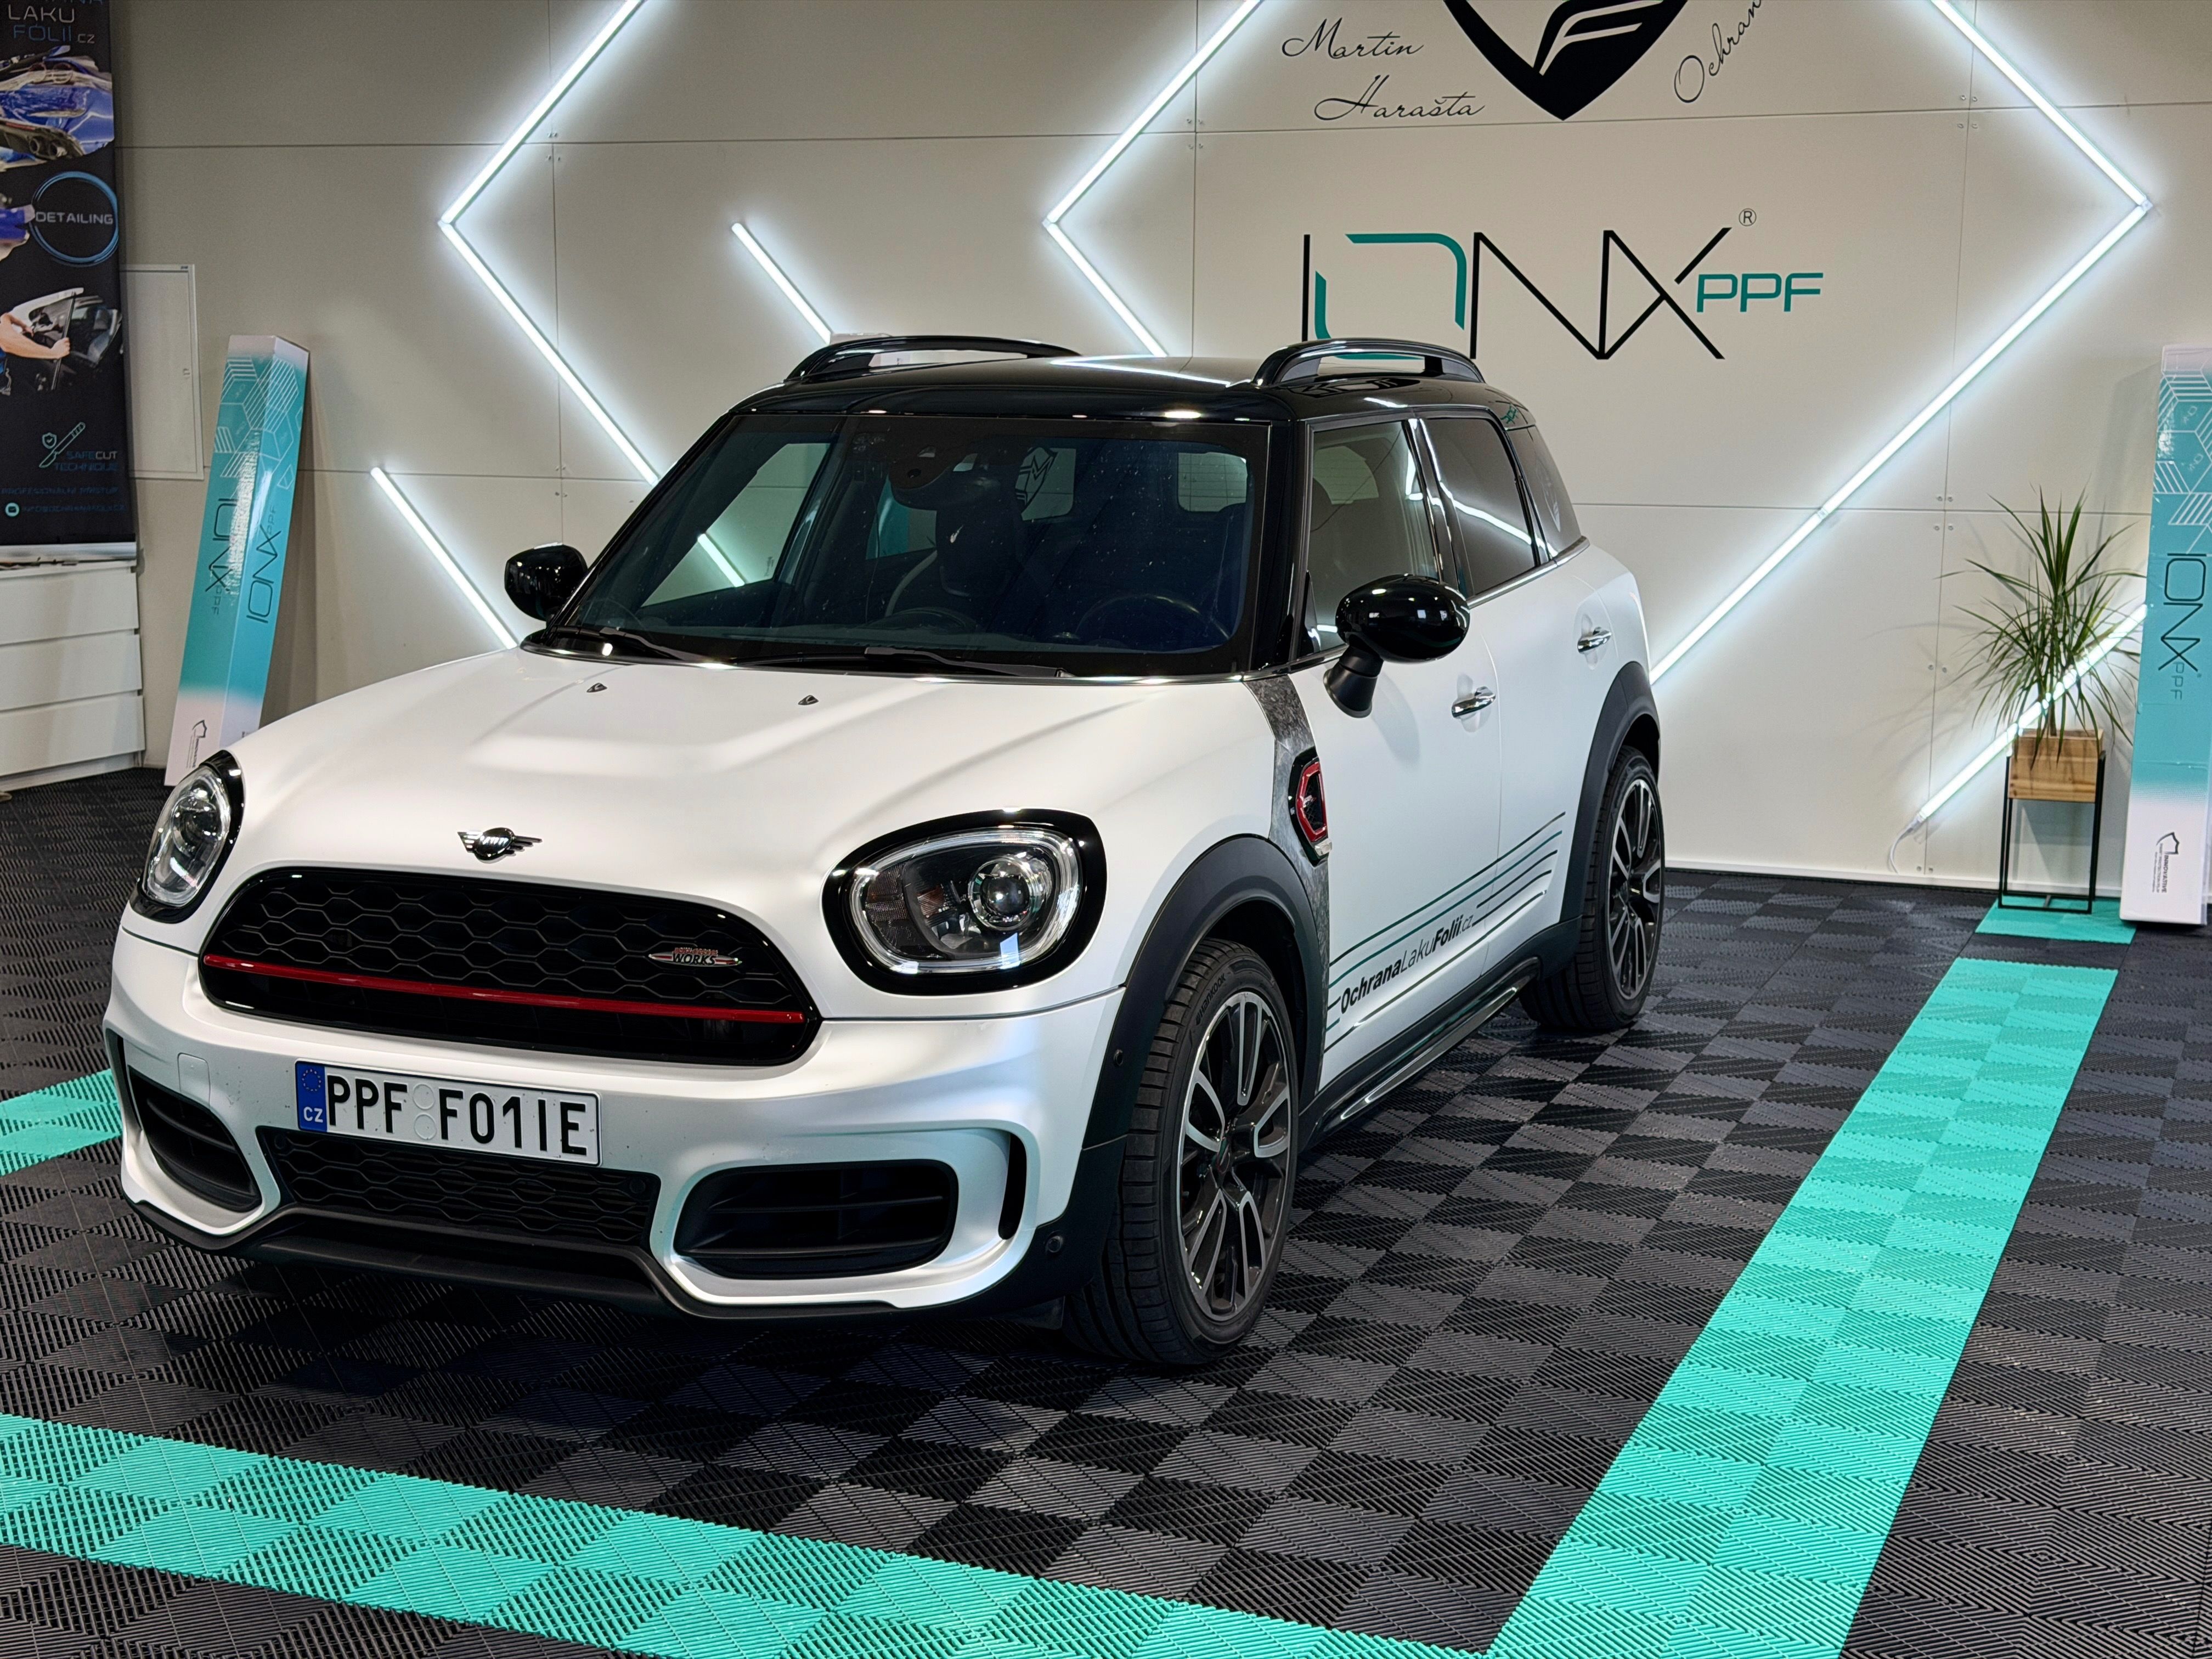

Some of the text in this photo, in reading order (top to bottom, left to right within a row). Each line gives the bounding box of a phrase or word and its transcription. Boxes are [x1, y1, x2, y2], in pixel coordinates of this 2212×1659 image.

[8, 4, 75, 23] LAKU
[1282, 18, 1425, 59] Martin
[1314, 74, 1485, 121] Harašta
[35, 211, 114, 225] DETAILING
[1301, 227, 1733, 360] IONX
[1696, 272, 1824, 313] PPF
[246, 523, 281, 624] IONX
[2158, 552, 2207, 701] IONX PPF
[673, 953, 715, 966] WORKS
[1341, 914, 1474, 1014] OchranaLakuFolii.cz
[303, 1105, 324, 1124] CZ
[327, 1074, 408, 1133] PPF
